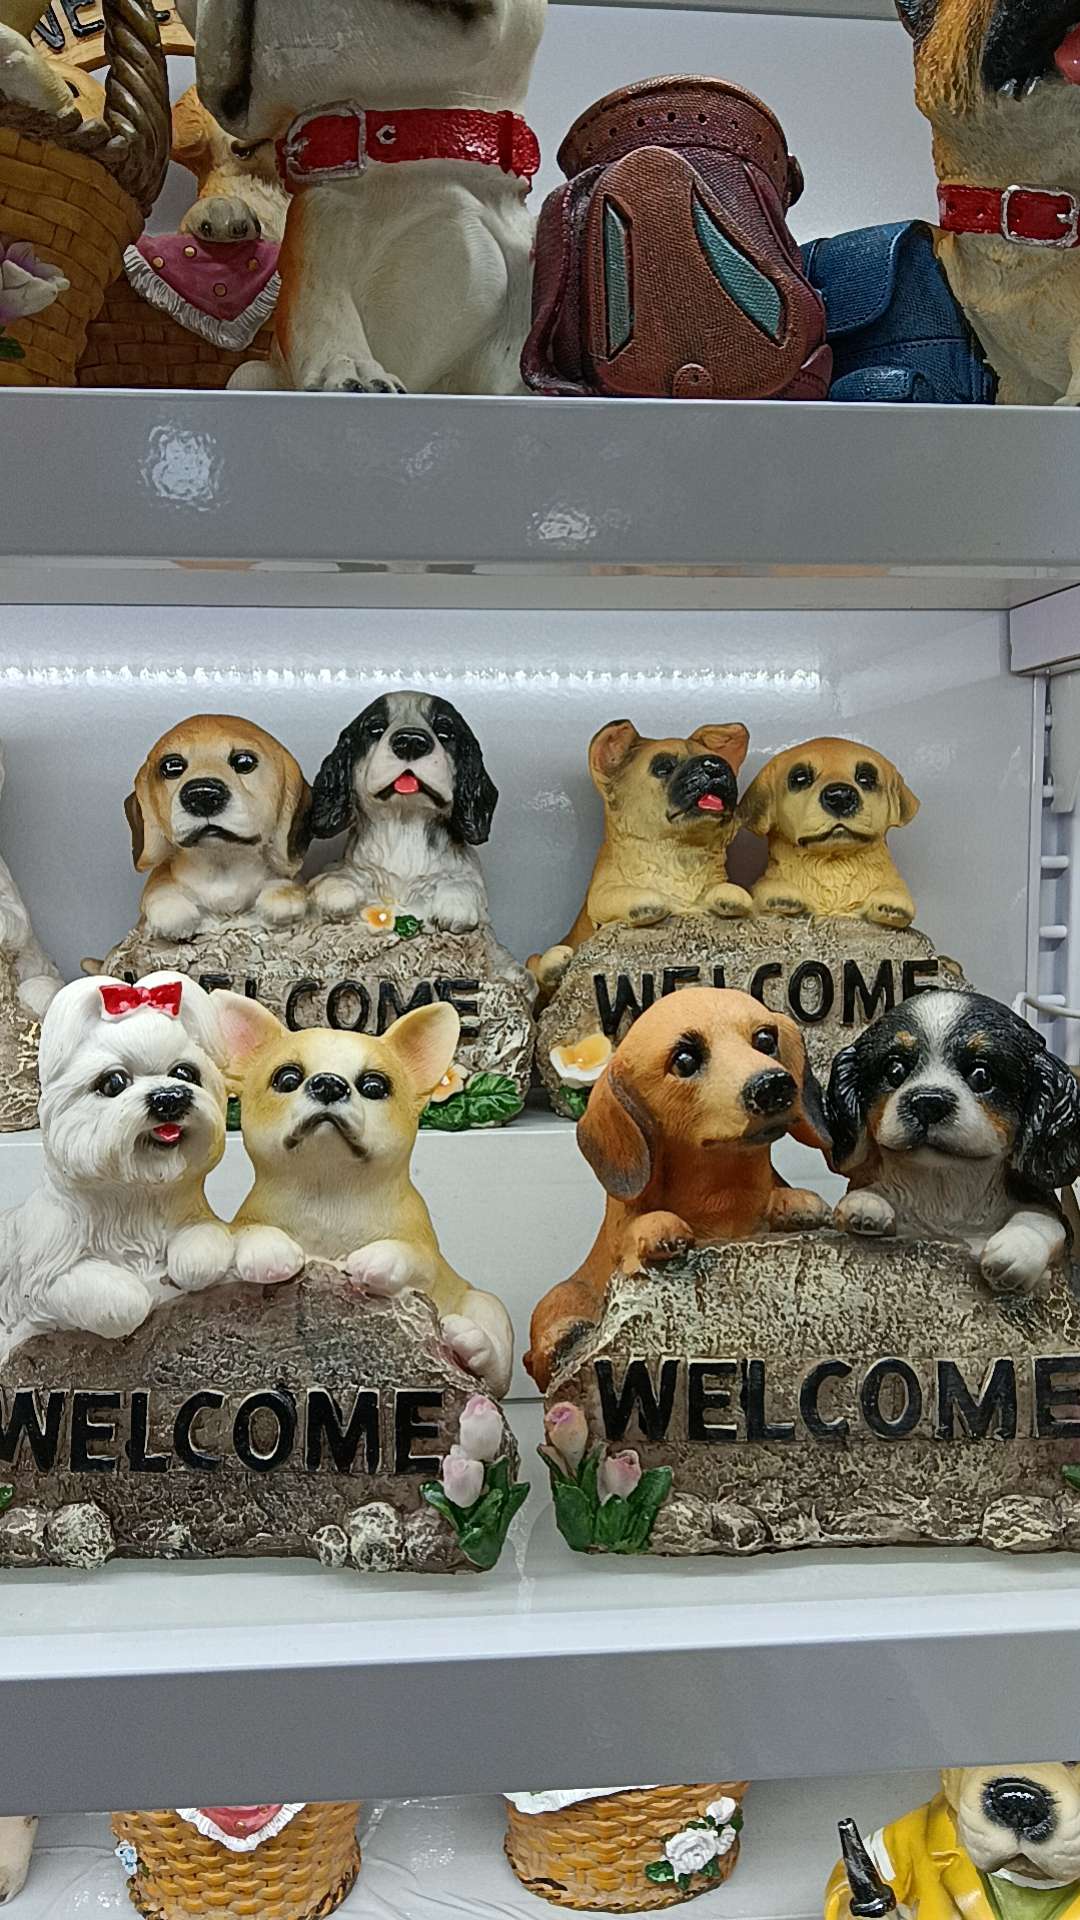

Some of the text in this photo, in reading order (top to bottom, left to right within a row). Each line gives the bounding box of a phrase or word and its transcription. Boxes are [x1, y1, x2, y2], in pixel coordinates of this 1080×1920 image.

[124, 973, 479, 1037] COME
[594, 959, 938, 1035] WCOME
[0, 1387, 444, 1473] WELCOME
[594, 1354, 1080, 1441] WELCOME
